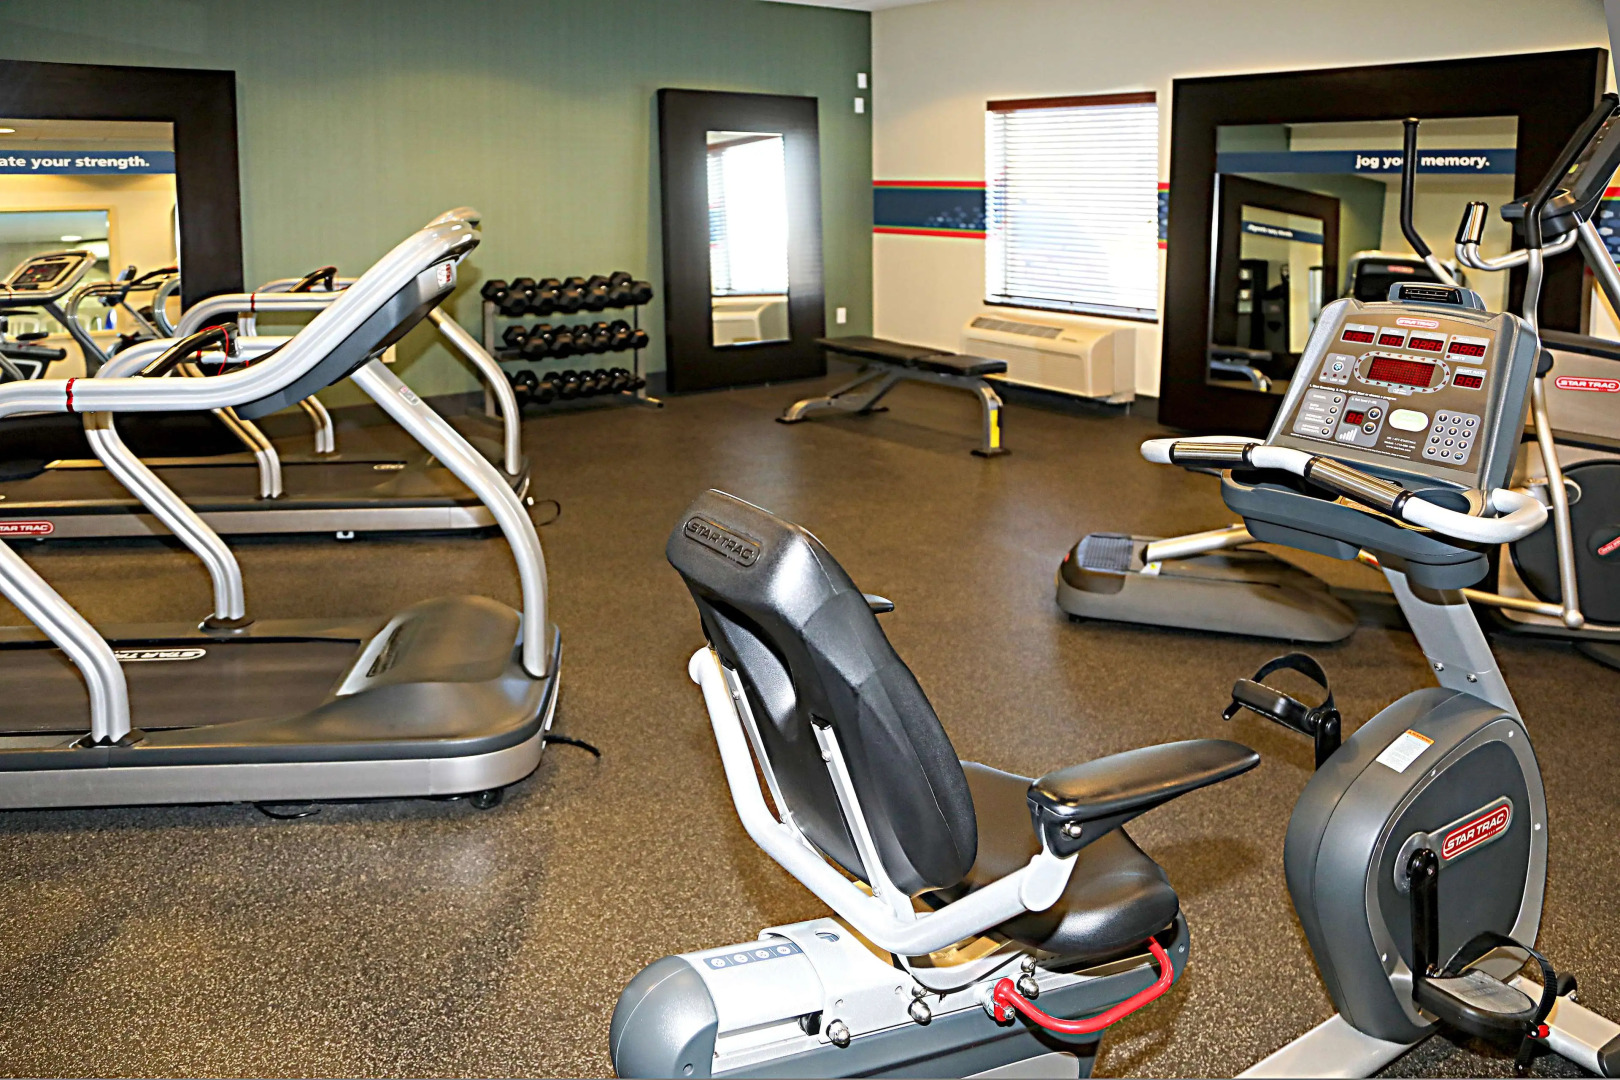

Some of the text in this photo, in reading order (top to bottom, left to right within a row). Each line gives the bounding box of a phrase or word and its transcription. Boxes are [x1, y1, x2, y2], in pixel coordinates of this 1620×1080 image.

[31, 158, 71, 169] your
[75, 155, 150, 169] strength.
[1355, 154, 1380, 169] jog
[1420, 156, 1490, 169] memory.
[689, 522, 754, 560] STAR TRAC
[1447, 812, 1505, 850] STAR TRAC
